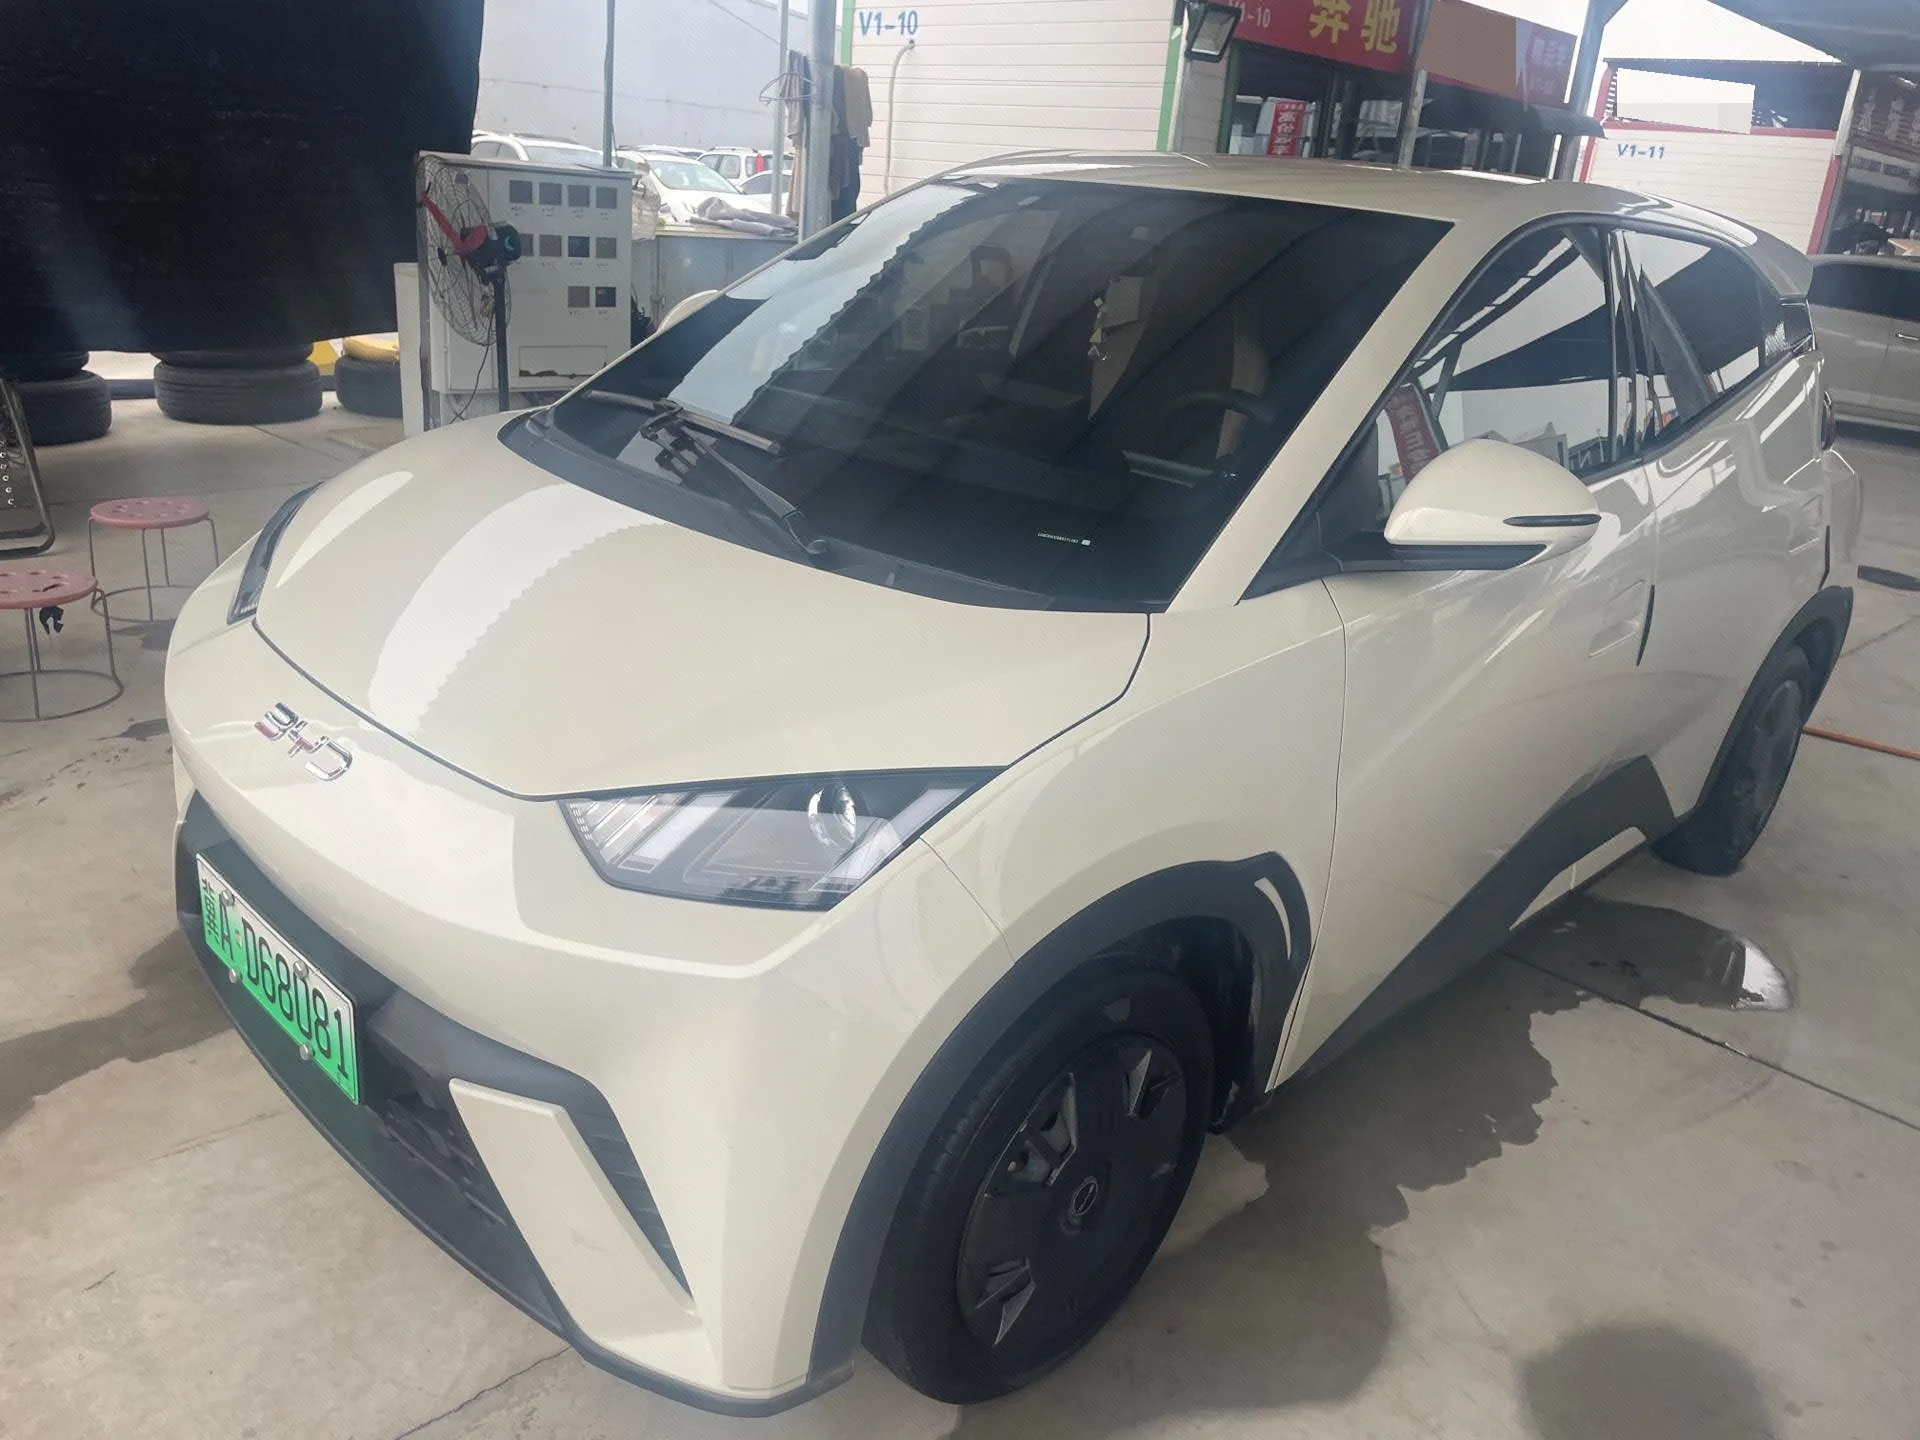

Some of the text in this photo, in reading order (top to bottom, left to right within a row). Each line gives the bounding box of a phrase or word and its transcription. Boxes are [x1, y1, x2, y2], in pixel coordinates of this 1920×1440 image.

[859, 10, 918, 36] V1-10
[1310, 0, 1399, 53] 奔驰
[1617, 143, 1665, 160] V1-11
[254, 702, 352, 781] BYD
